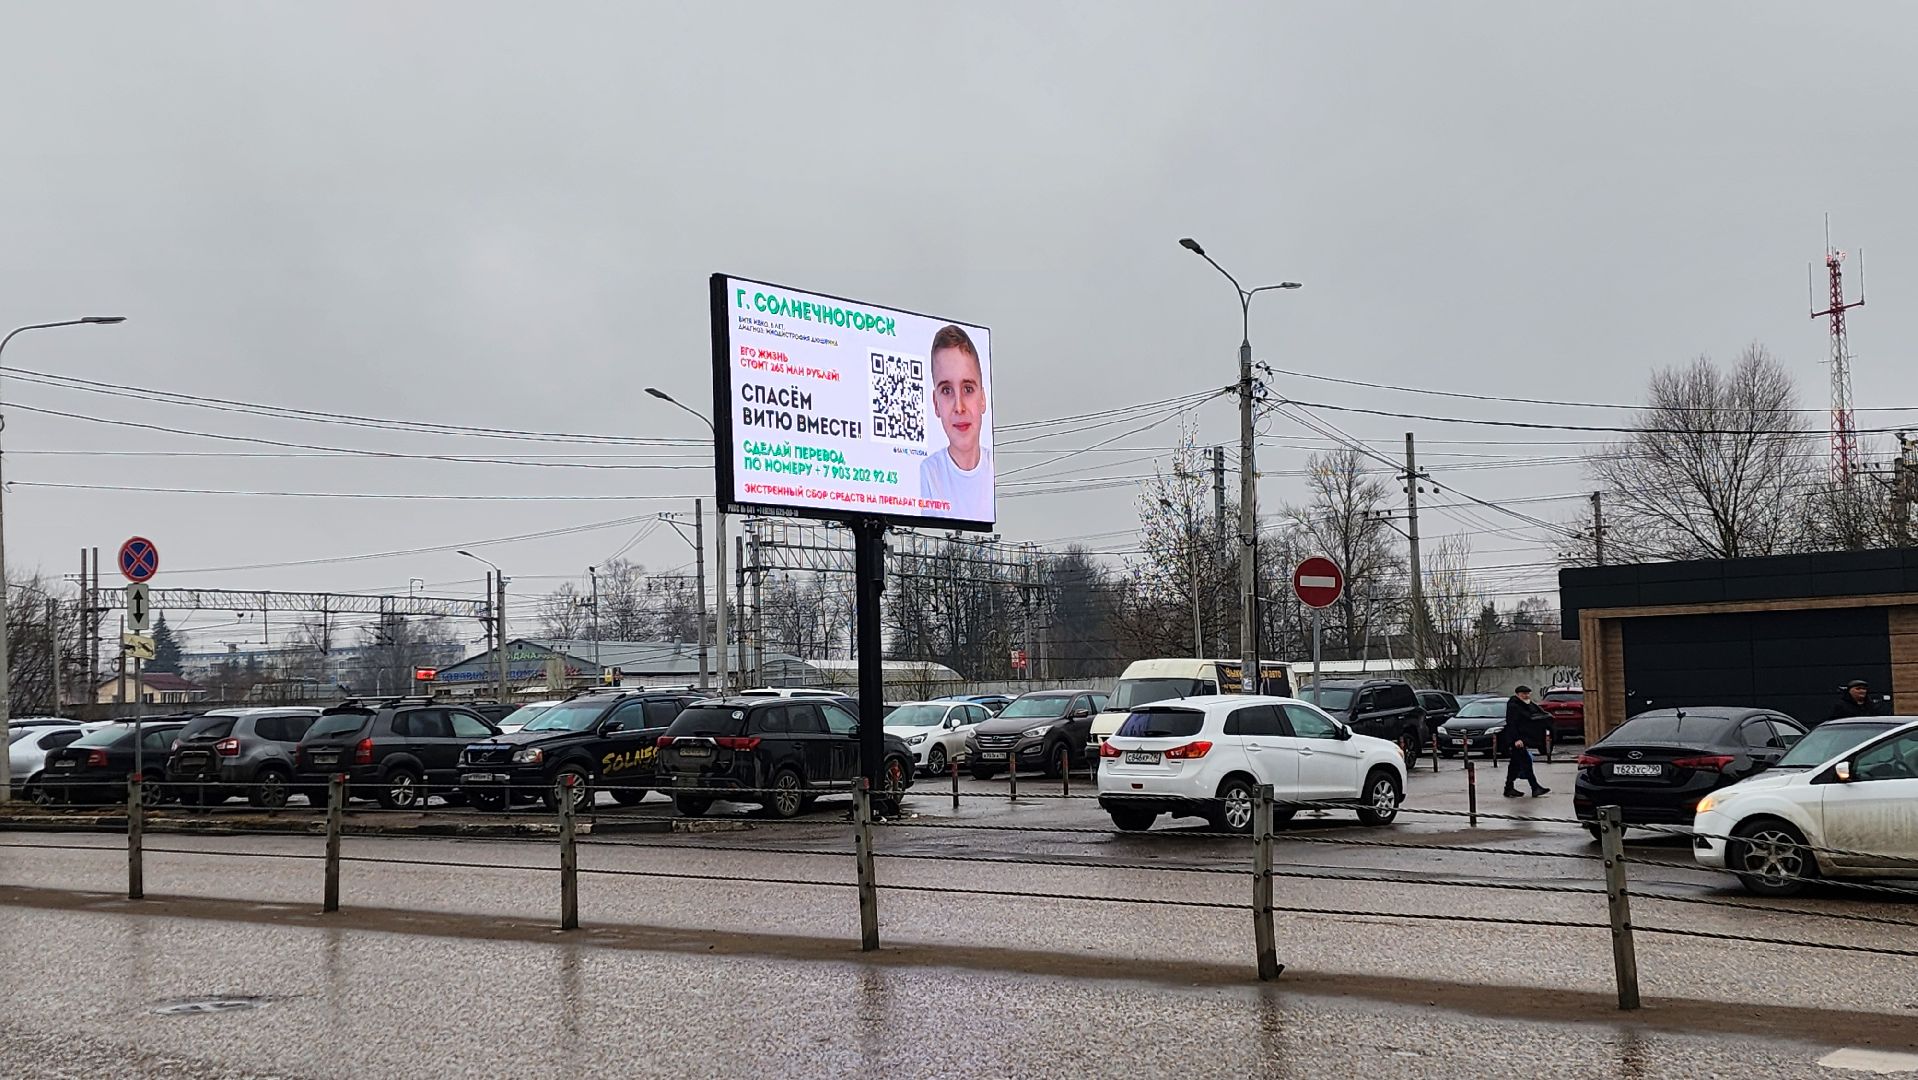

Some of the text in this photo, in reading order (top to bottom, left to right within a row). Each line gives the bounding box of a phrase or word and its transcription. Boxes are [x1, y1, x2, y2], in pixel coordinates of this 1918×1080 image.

[736, 288, 896, 336] Г. СОЛНЕЧНОГОРСК
[740, 346, 788, 363] ЕГО ЖИЗНЬ
[740, 358, 768, 371] СТОИТ
[787, 365, 804, 376] МЛН
[742, 383, 812, 410] СПАСЁМ
[743, 407, 861, 439] ВИТЮ ВМЕСТЕ!
[743, 440, 846, 464] СДЕЛАЙ ПЕРЕВОД
[744, 456, 761, 471] ПО
[765, 460, 812, 476] НОМЕРУ
[823, 465, 829, 477] 7
[832, 466, 850, 481] 903
[853, 467, 871, 482] 202
[873, 469, 885, 483] 92
[744, 483, 803, 497] ЭКСТРЕННЫЙ
[805, 488, 828, 500] СБОР
[830, 491, 865, 503] СРЕДСТВ
[867, 494, 877, 503] НА
[879, 495, 916, 507] ПРЕПАРАТ
